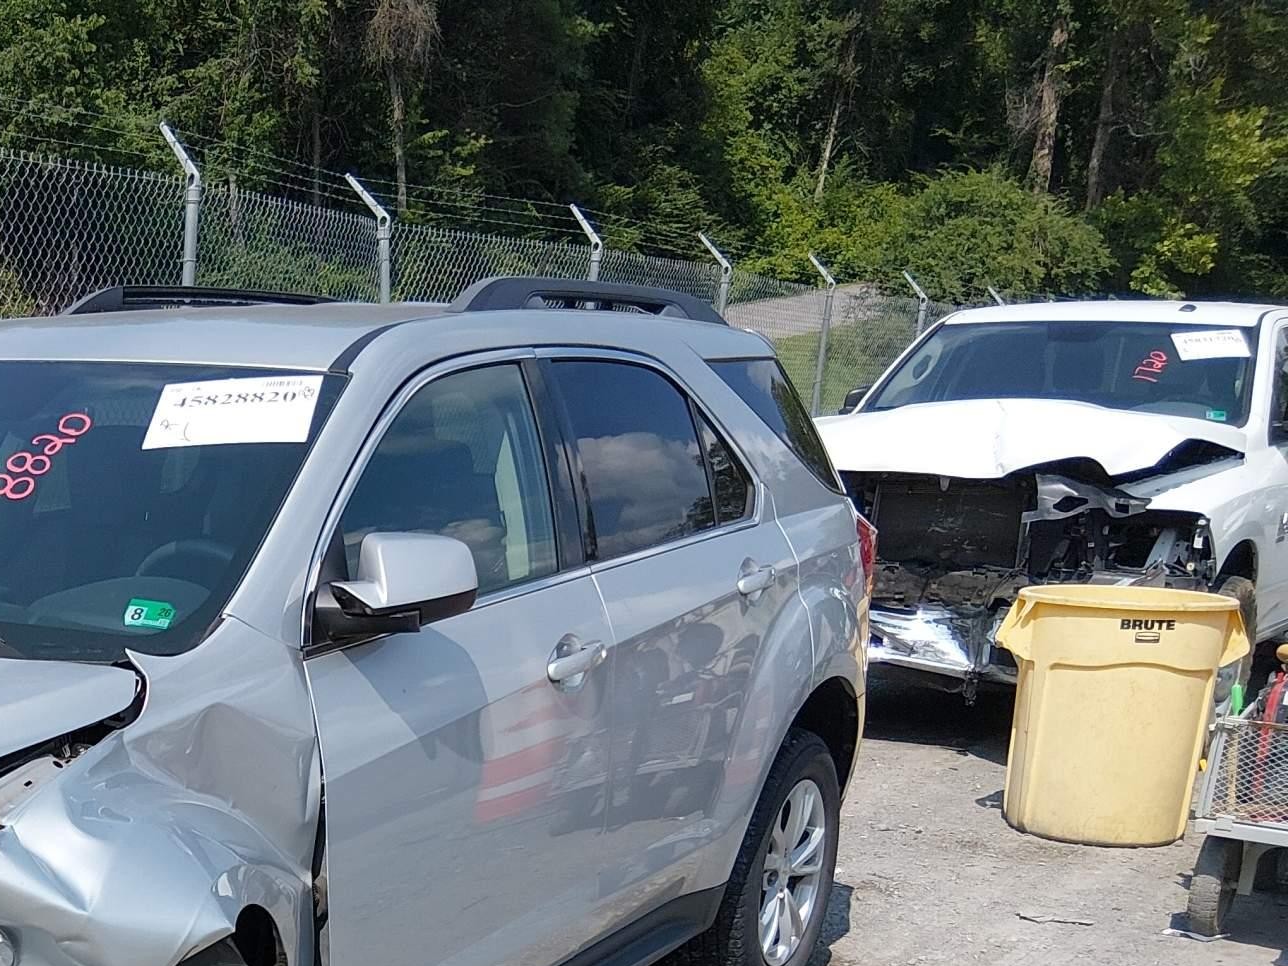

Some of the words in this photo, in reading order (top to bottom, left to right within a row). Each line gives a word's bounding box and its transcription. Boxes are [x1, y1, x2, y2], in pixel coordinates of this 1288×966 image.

[1132, 351, 1168, 382] 1720
[173, 390, 297, 408] 45828820
[131, 607, 144, 620] 8
[1120, 618, 1176, 630] BRUTE
